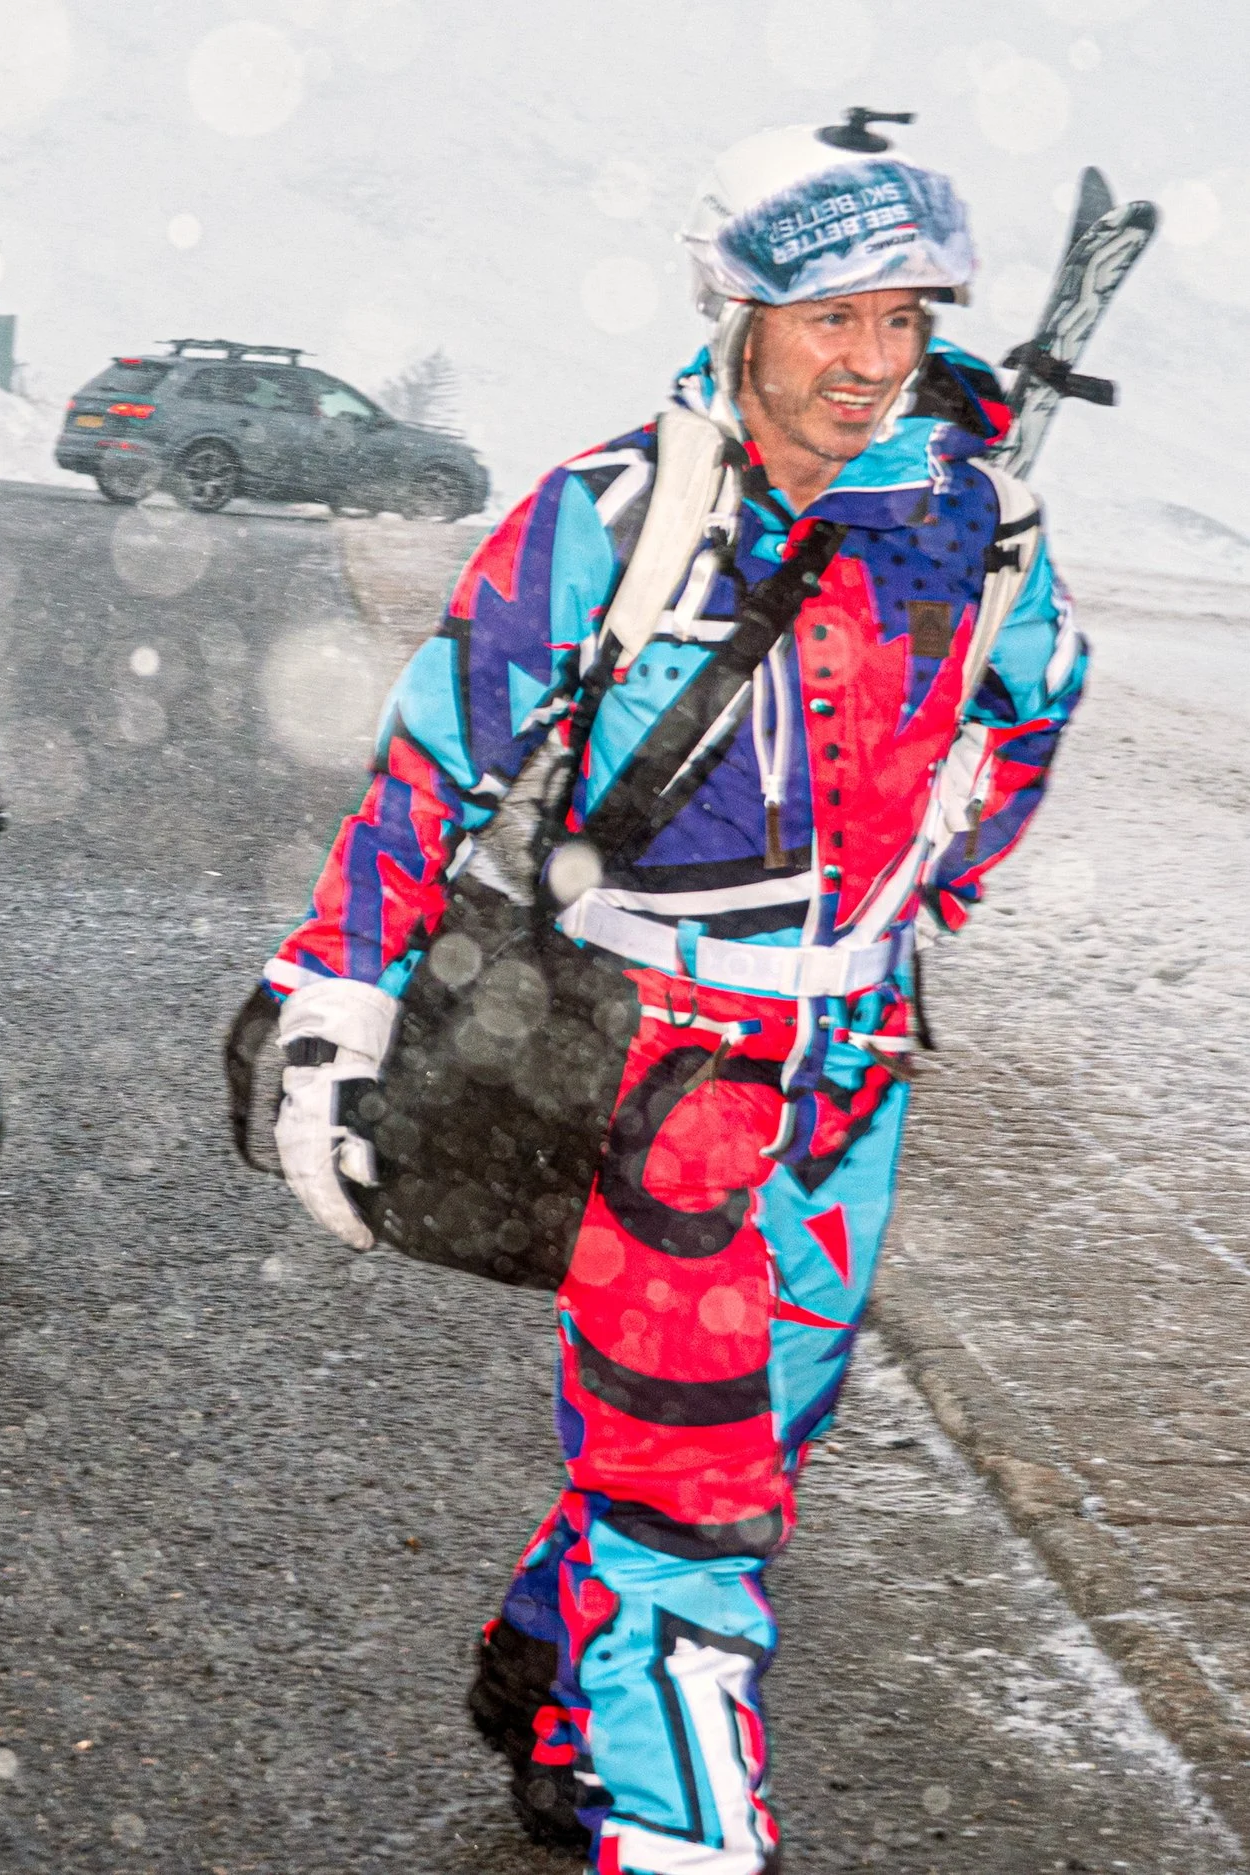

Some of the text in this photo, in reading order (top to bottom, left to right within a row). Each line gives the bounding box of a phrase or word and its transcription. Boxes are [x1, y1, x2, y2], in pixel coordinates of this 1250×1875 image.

[861, 182, 900, 207] SKI
[772, 203, 910, 265] SEE BETTER
